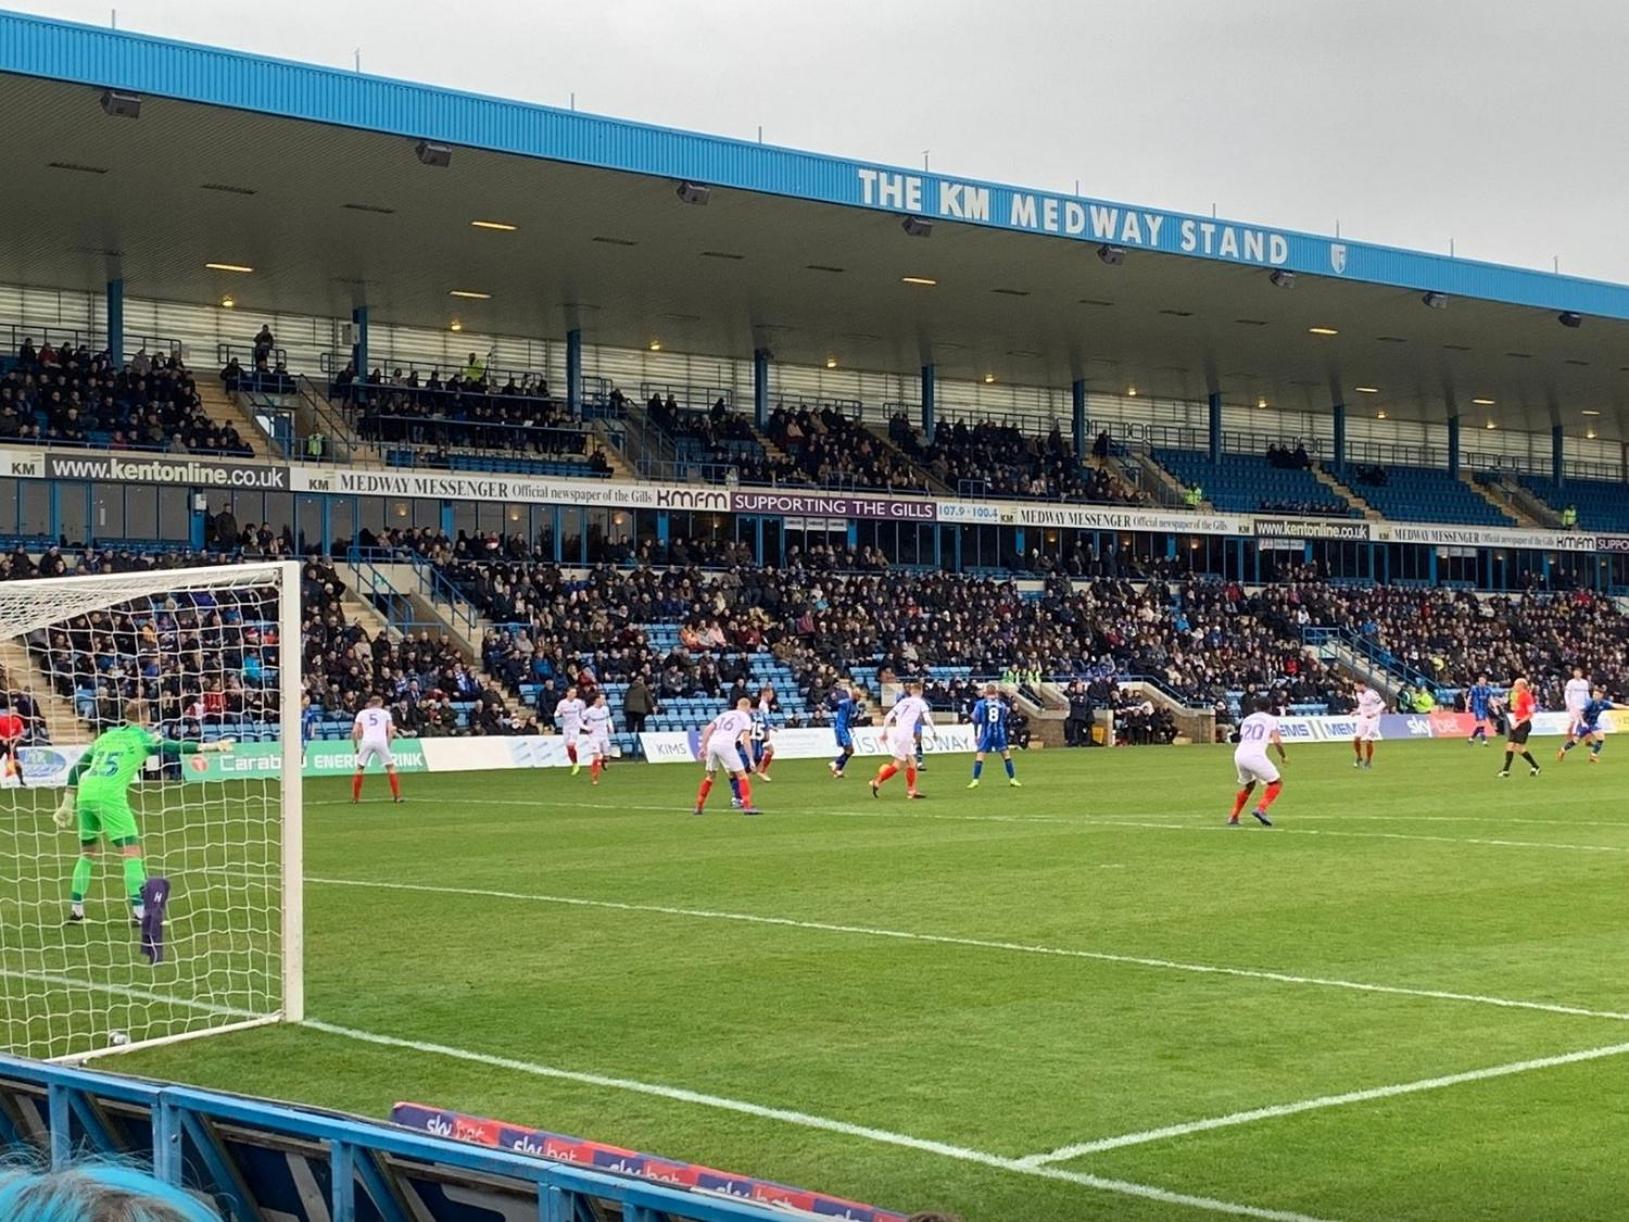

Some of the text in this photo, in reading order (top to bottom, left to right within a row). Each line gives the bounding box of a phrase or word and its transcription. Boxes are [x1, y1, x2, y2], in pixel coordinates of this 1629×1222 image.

[859, 169, 1289, 265] THE KM MEDWAY STAND
[12, 463, 36, 475] KM
[53, 459, 284, 488] www.kentonline.co.uk
[309, 479, 329, 491] KM
[341, 474, 652, 504] MEDWAY MESSENGER Official newspaper of the Gills
[736, 496, 932, 517] SUPPORTING THE GILLS
[1020, 509, 1066, 525] MEDWAY
[1068, 512, 1130, 528] MESSENGER
[1257, 521, 1367, 539] www.kentonline.co.uk
[1395, 528, 1431, 542] MEDWAY
[1432, 531, 1479, 544] MESSENGER
[901, 703, 912, 718] 7
[988, 706, 1000, 723] 8
[369, 713, 379, 727] 5
[715, 716, 735, 732] 16
[1407, 715, 1432, 738] sky
[750, 721, 767, 741] 15
[1243, 723, 1265, 741] 20
[1279, 723, 1310, 737] EMS
[656, 743, 687, 756] KIMS
